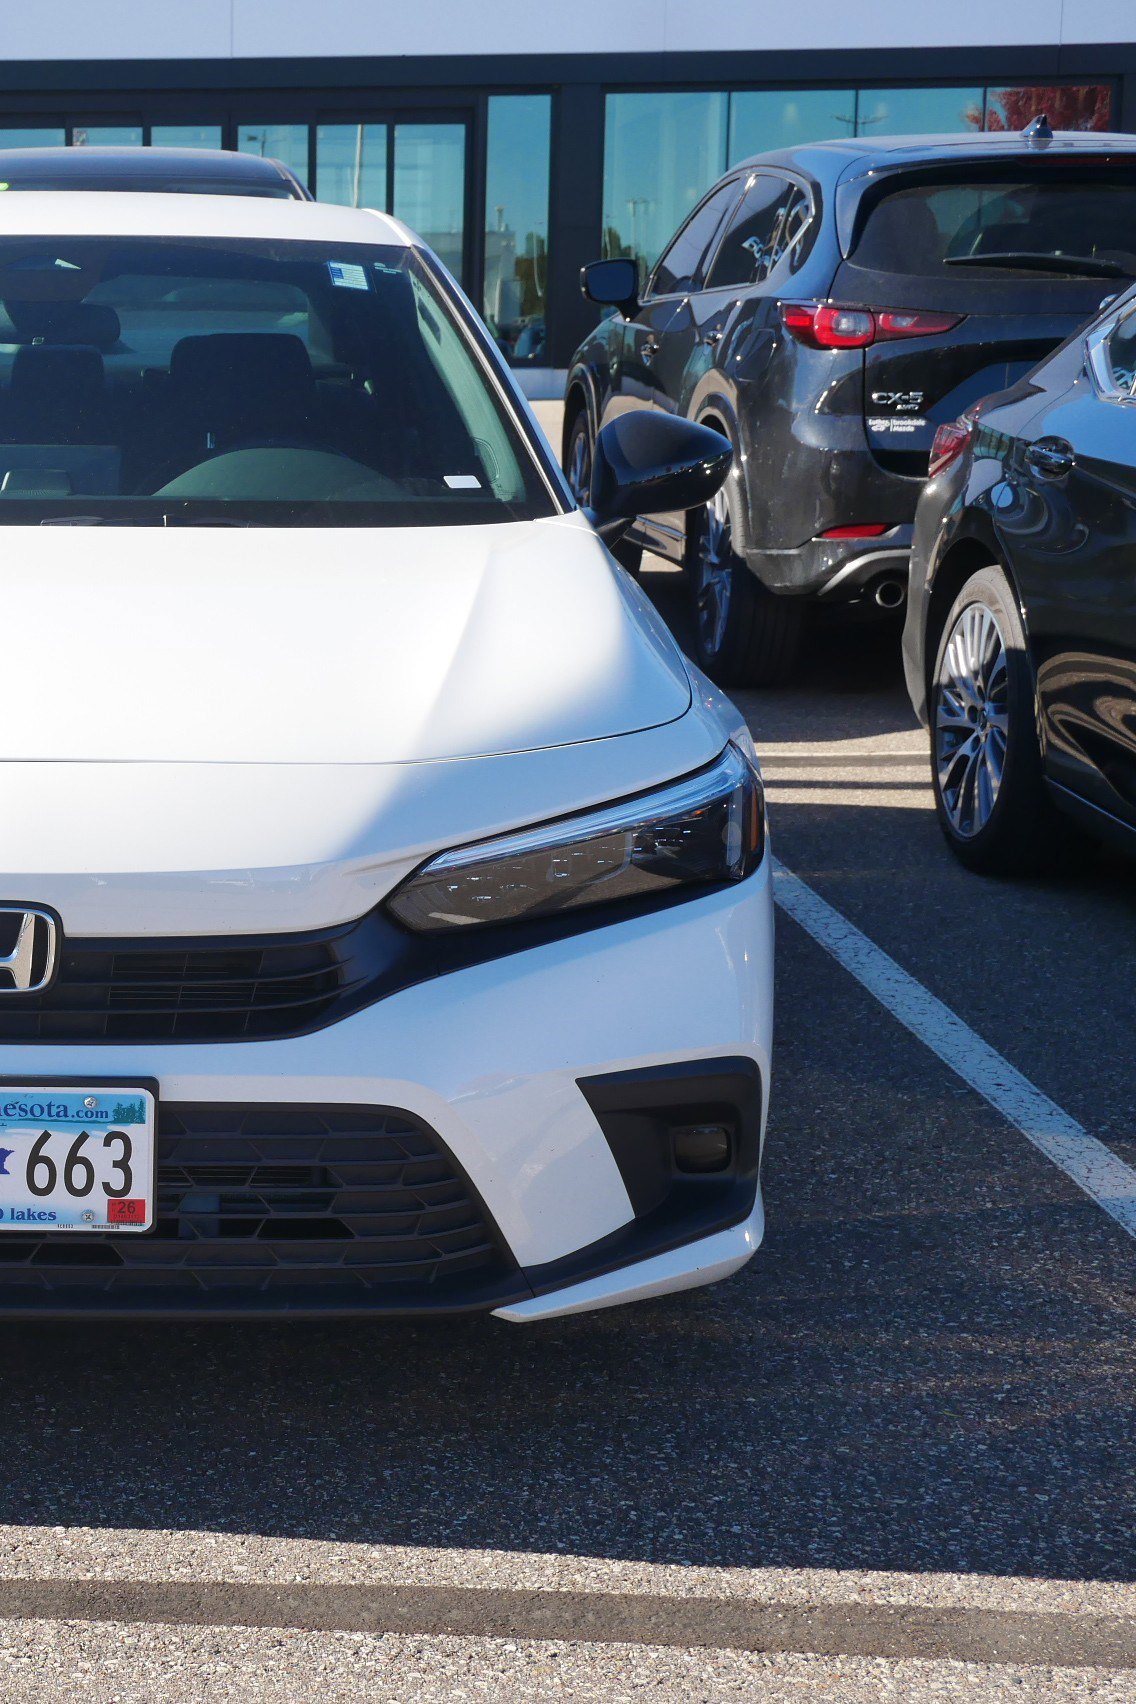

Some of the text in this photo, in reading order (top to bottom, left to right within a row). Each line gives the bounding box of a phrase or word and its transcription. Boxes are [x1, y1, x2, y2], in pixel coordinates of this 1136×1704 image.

[872, 391, 924, 404] CX-5
[25, 1129, 134, 1199] 663
[9, 1206, 57, 1222] lakes
[117, 1201, 136, 1214] 26
